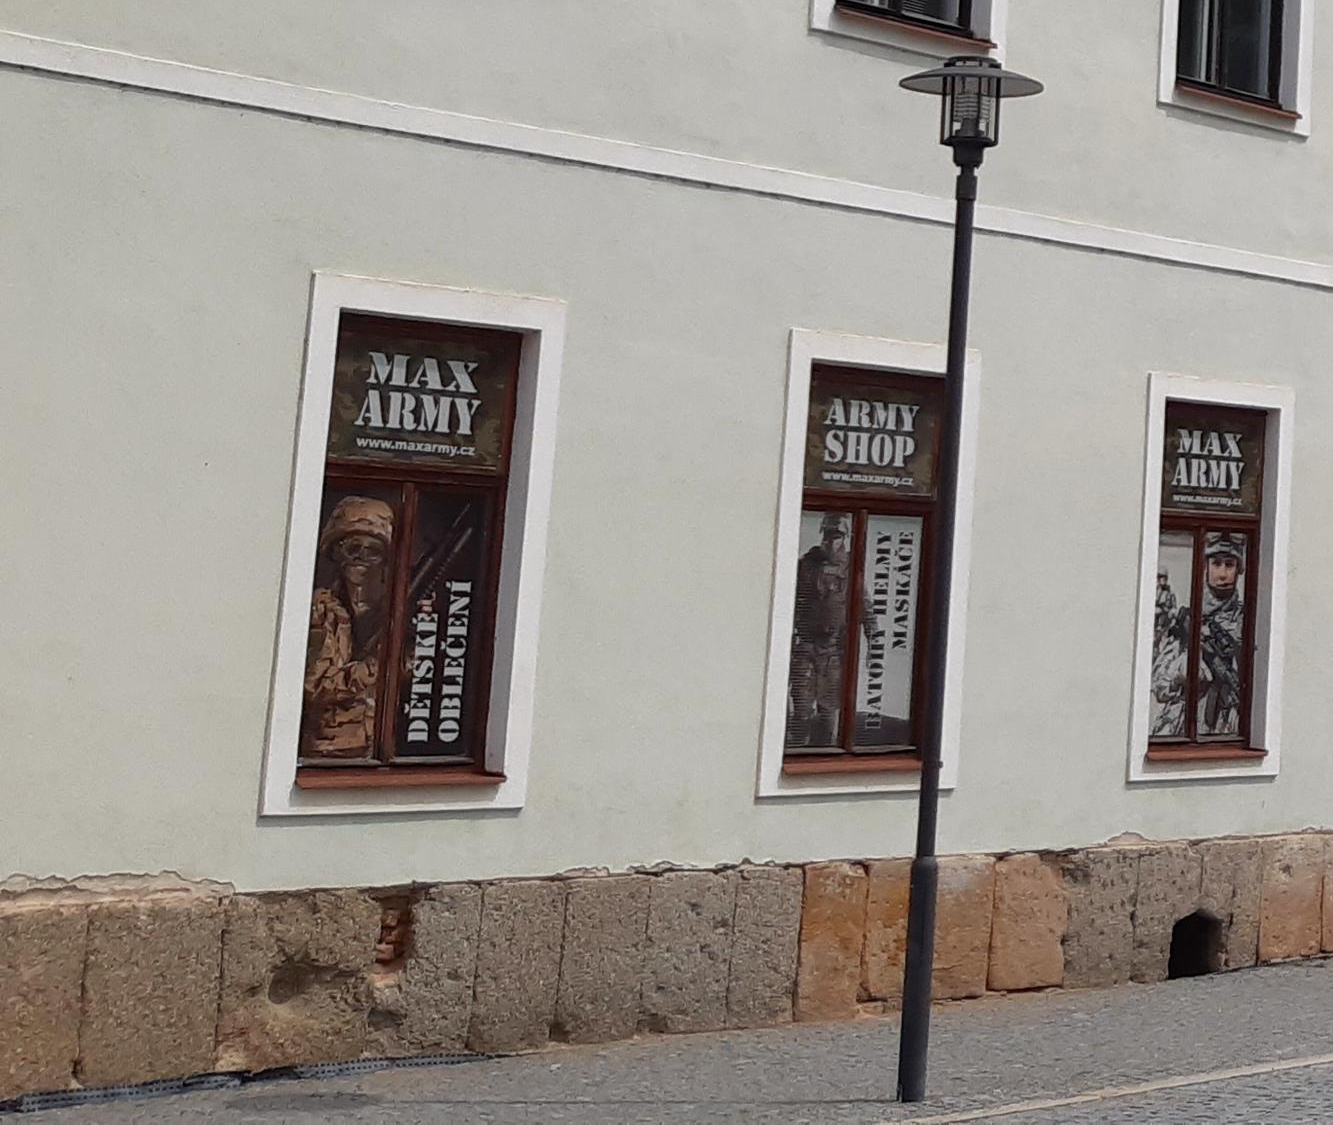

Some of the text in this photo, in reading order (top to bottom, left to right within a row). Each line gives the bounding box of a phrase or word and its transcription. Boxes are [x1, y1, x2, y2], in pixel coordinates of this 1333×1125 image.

[366, 351, 479, 394] MAX
[354, 389, 482, 435] ARMY
[823, 398, 920, 432] ARMY
[356, 437, 476, 456] www.maxarmy.cz
[824, 429, 915, 467] SHOP
[1177, 429, 1243, 457] MAX
[822, 471, 914, 487] www.maxarmy.cz
[1171, 457, 1245, 489] ARMY
[873, 531, 892, 616] HELMY
[892, 531, 914, 650] MASKÁČE
[404, 612, 439, 743] DĚTSKÉ
[437, 580, 472, 743] OBLEČENÍ
